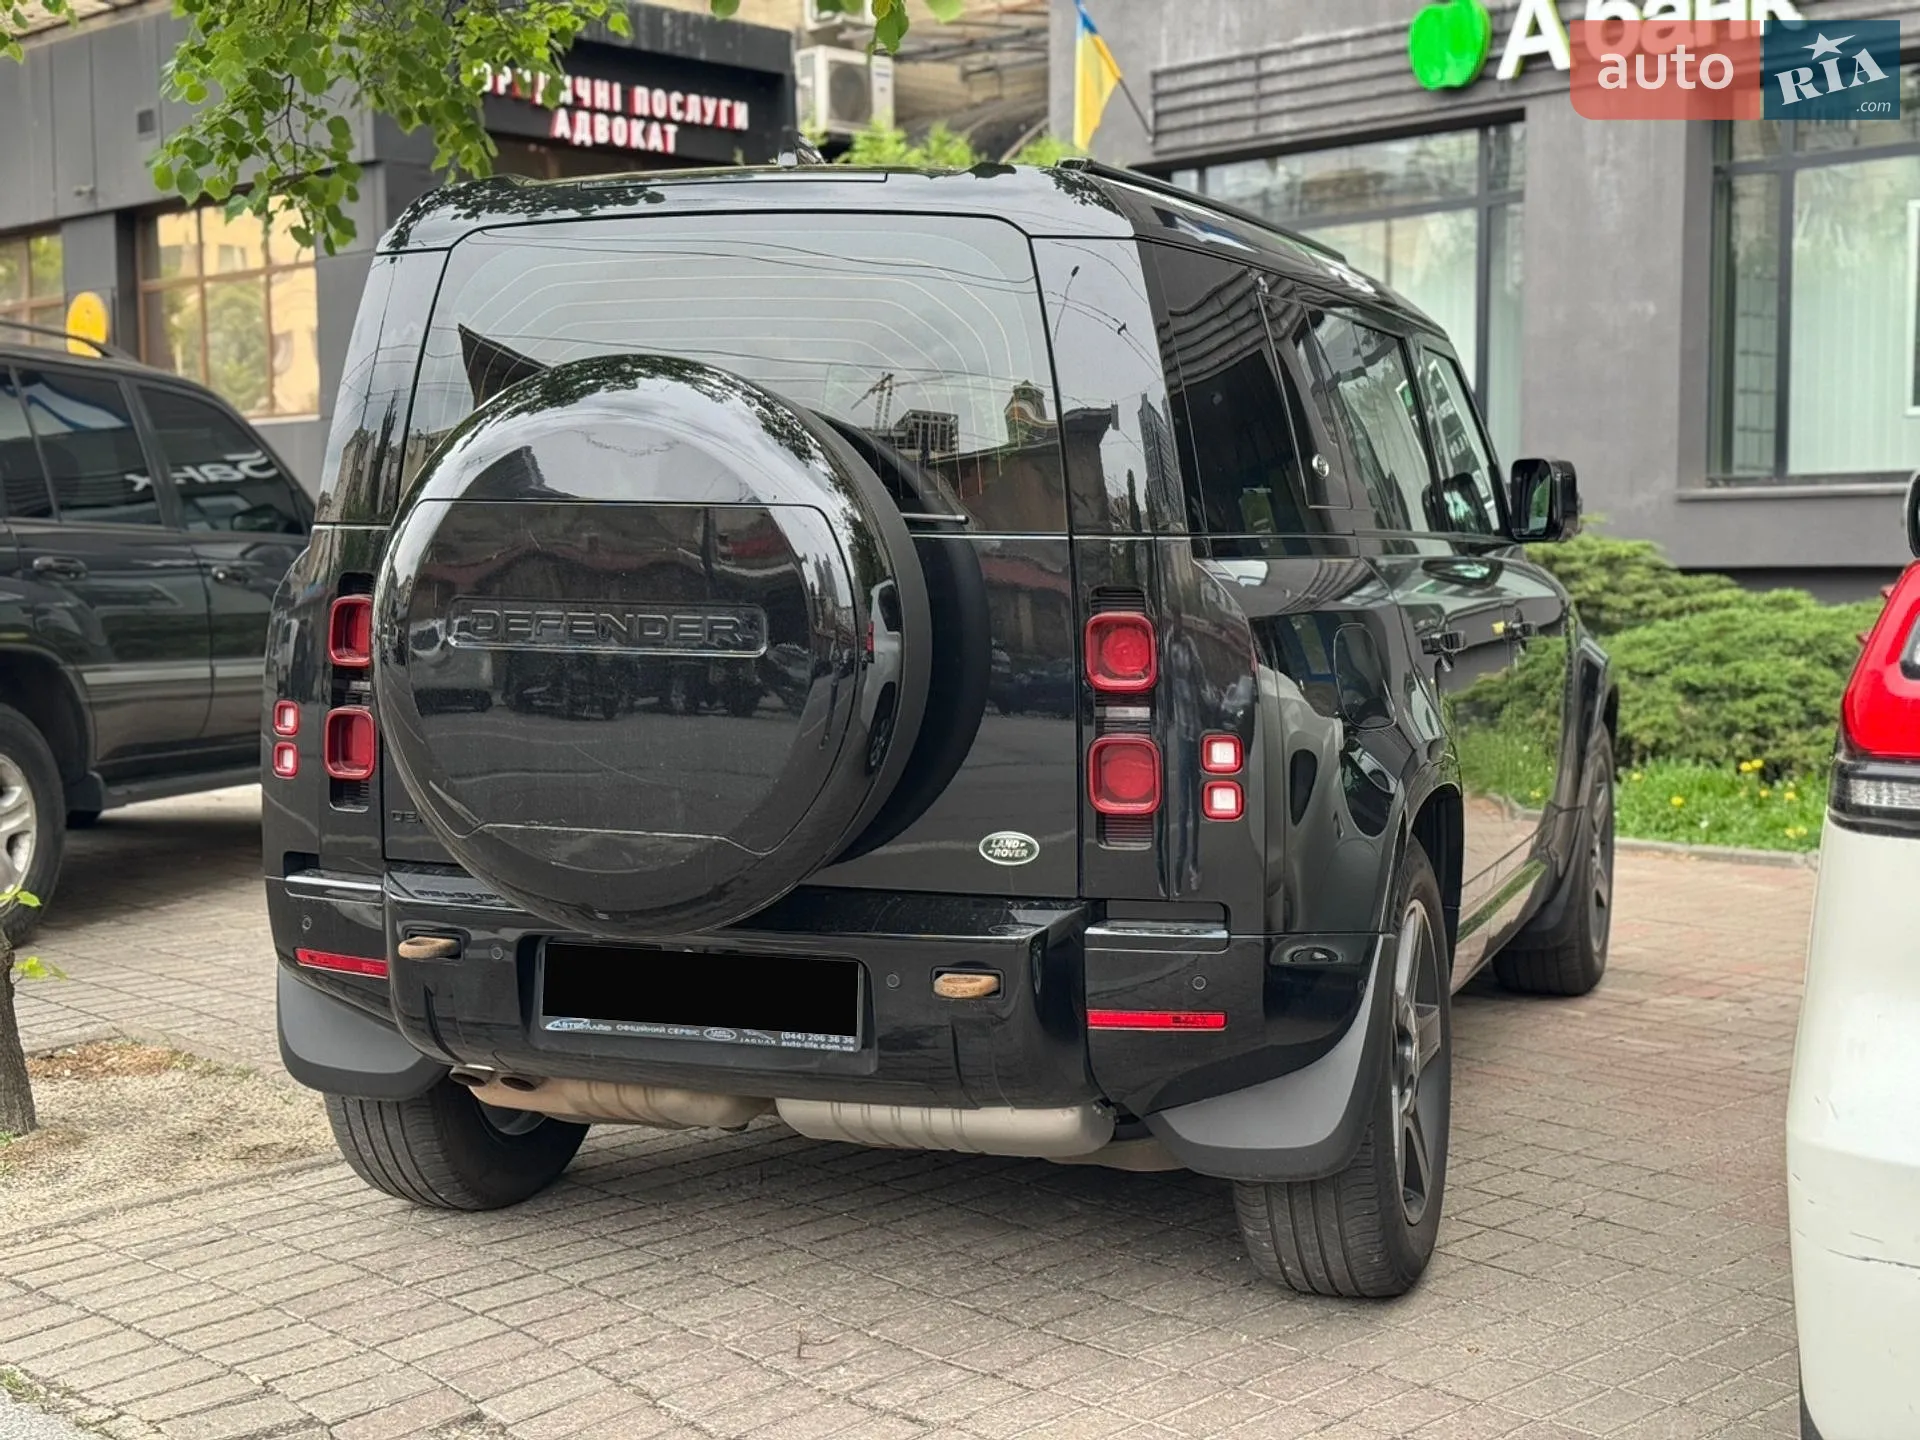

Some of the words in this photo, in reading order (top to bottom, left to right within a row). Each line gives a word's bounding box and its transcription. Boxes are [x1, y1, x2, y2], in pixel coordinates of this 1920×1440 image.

[550, 107, 679, 153] АДВОКАТ
[629, 85, 749, 131] ПОСЛУГИ
[470, 608, 744, 643] DEFENDER
